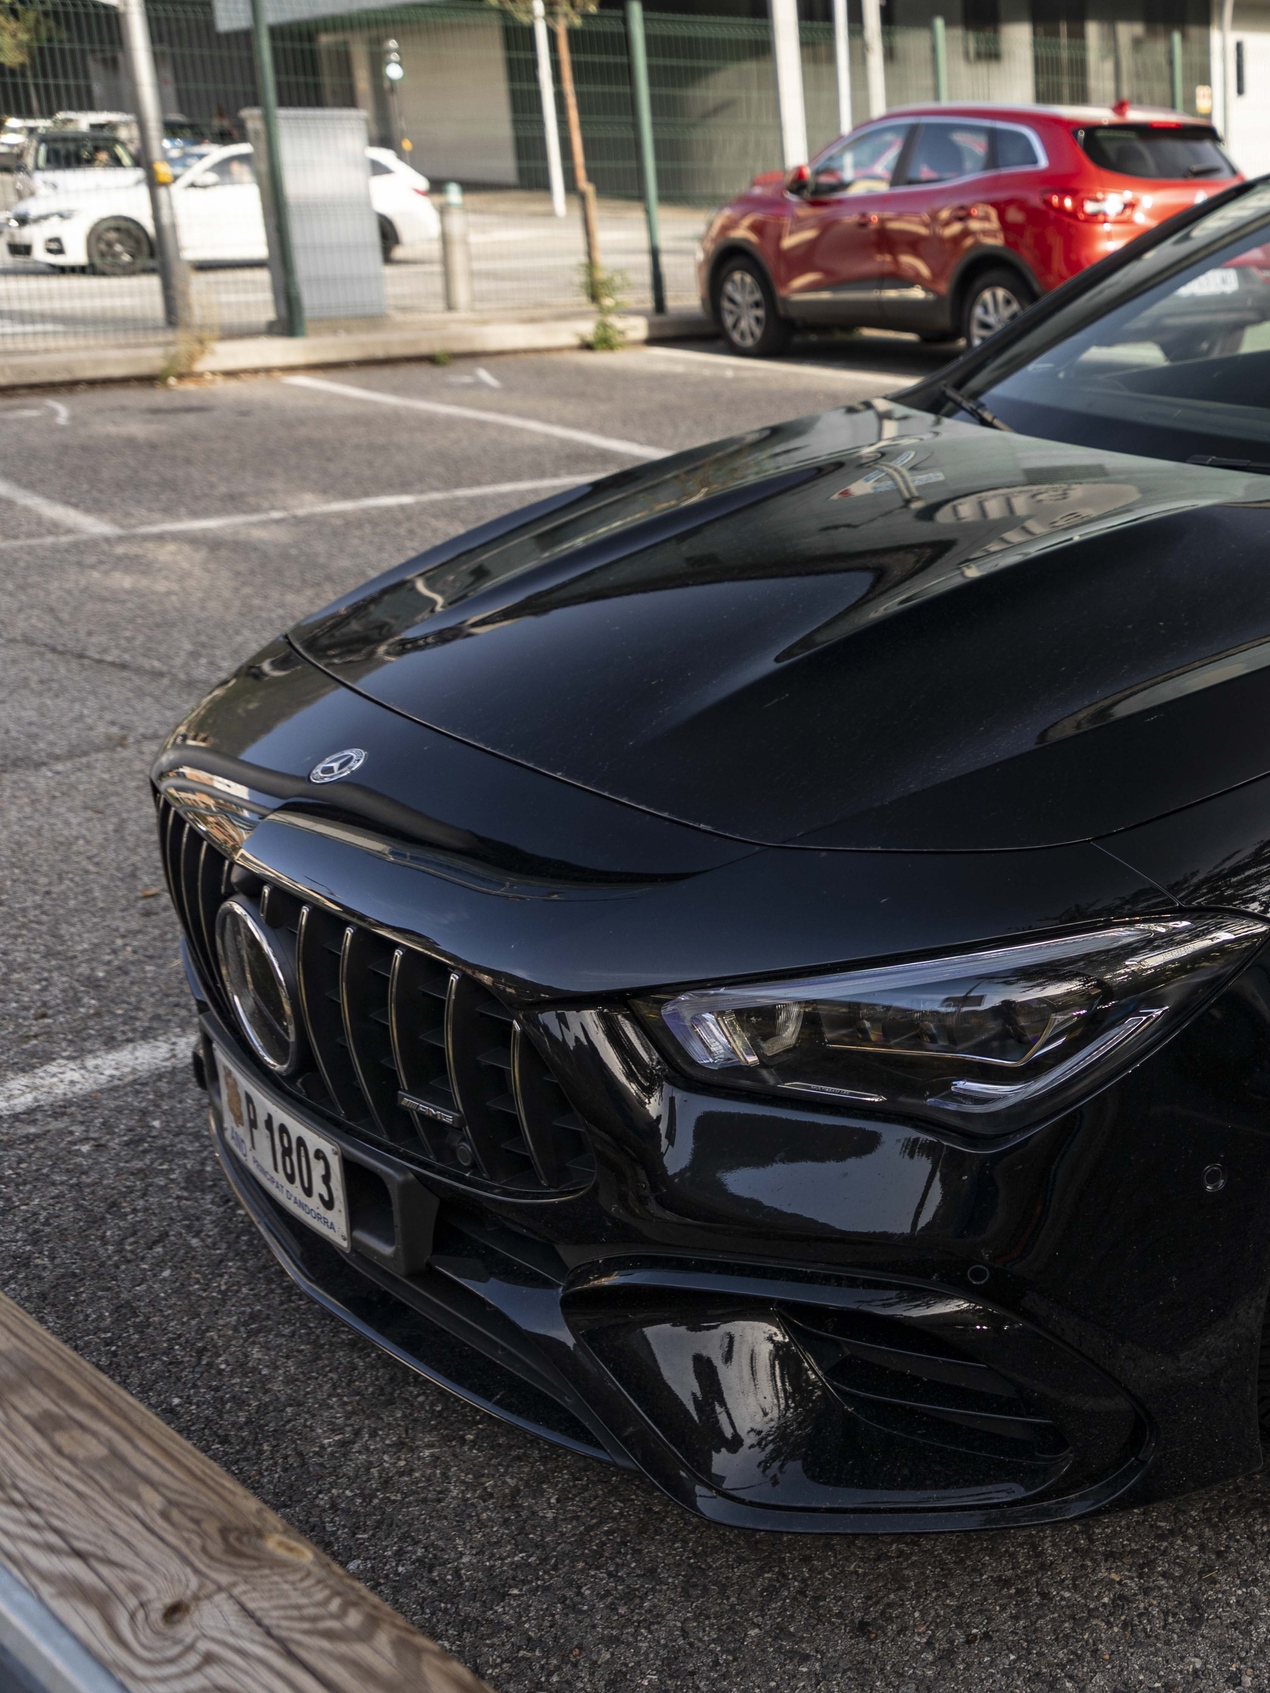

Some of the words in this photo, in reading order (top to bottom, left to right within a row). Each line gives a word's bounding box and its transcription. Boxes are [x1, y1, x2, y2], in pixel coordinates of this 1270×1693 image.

[244, 1090, 258, 1151] P
[264, 1112, 335, 1211] 1803
[252, 1156, 285, 1195] PRINCIPAT
[285, 1189, 336, 1233] D'ANDORRA
